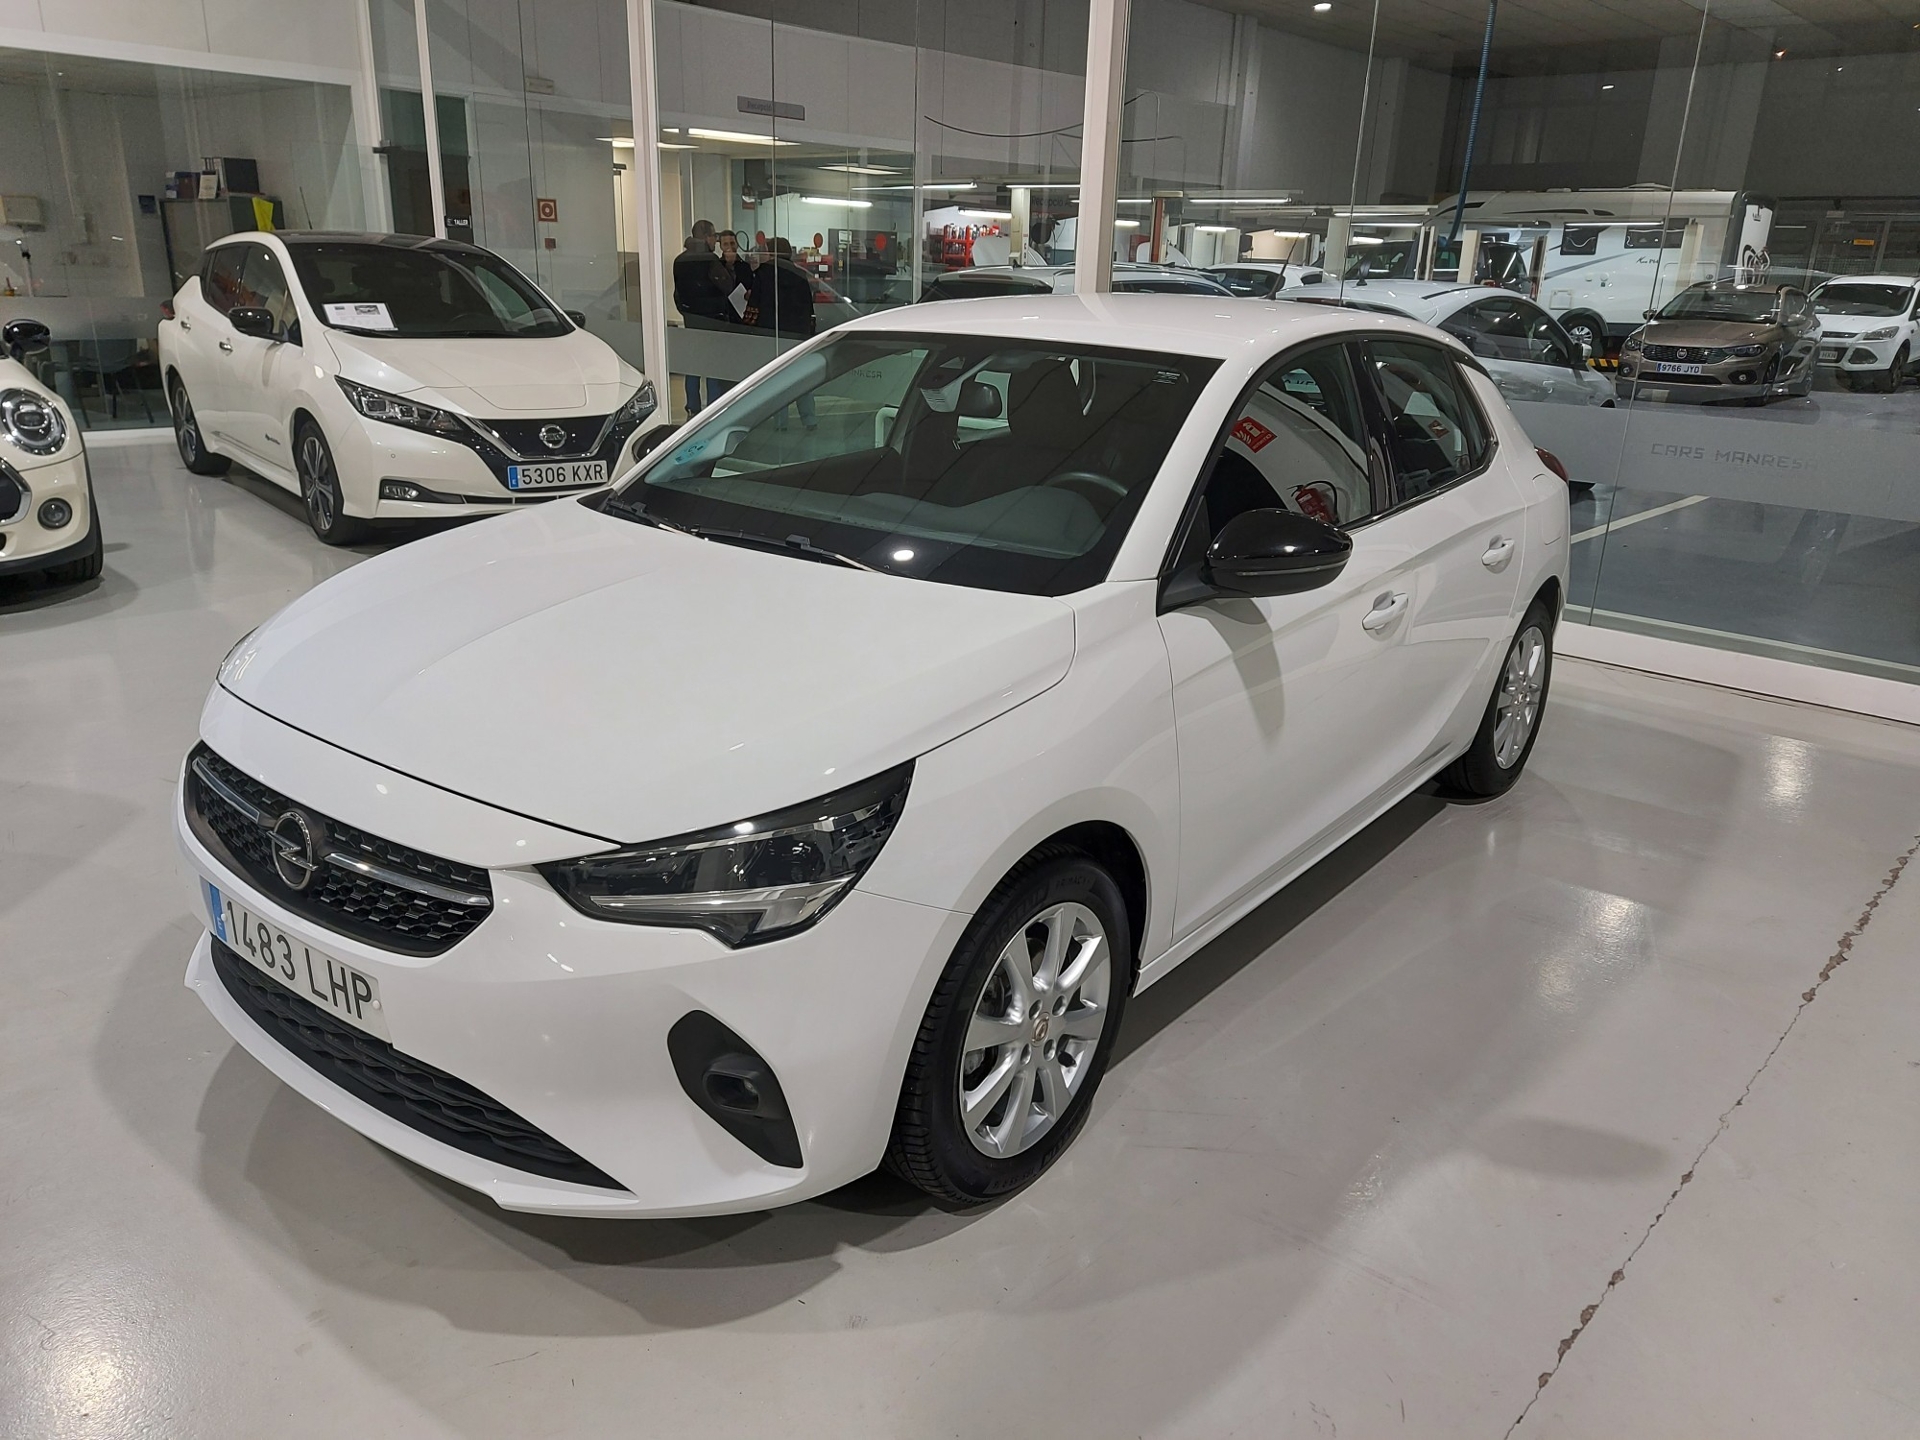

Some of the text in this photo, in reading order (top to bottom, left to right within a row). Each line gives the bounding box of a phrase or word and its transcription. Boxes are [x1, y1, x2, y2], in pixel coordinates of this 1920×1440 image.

[1661, 364, 1682, 373] 9766
[1650, 443, 1706, 460] CARS
[521, 464, 603, 485] 5306 KXR
[226, 900, 372, 1020] 1483 LHP
